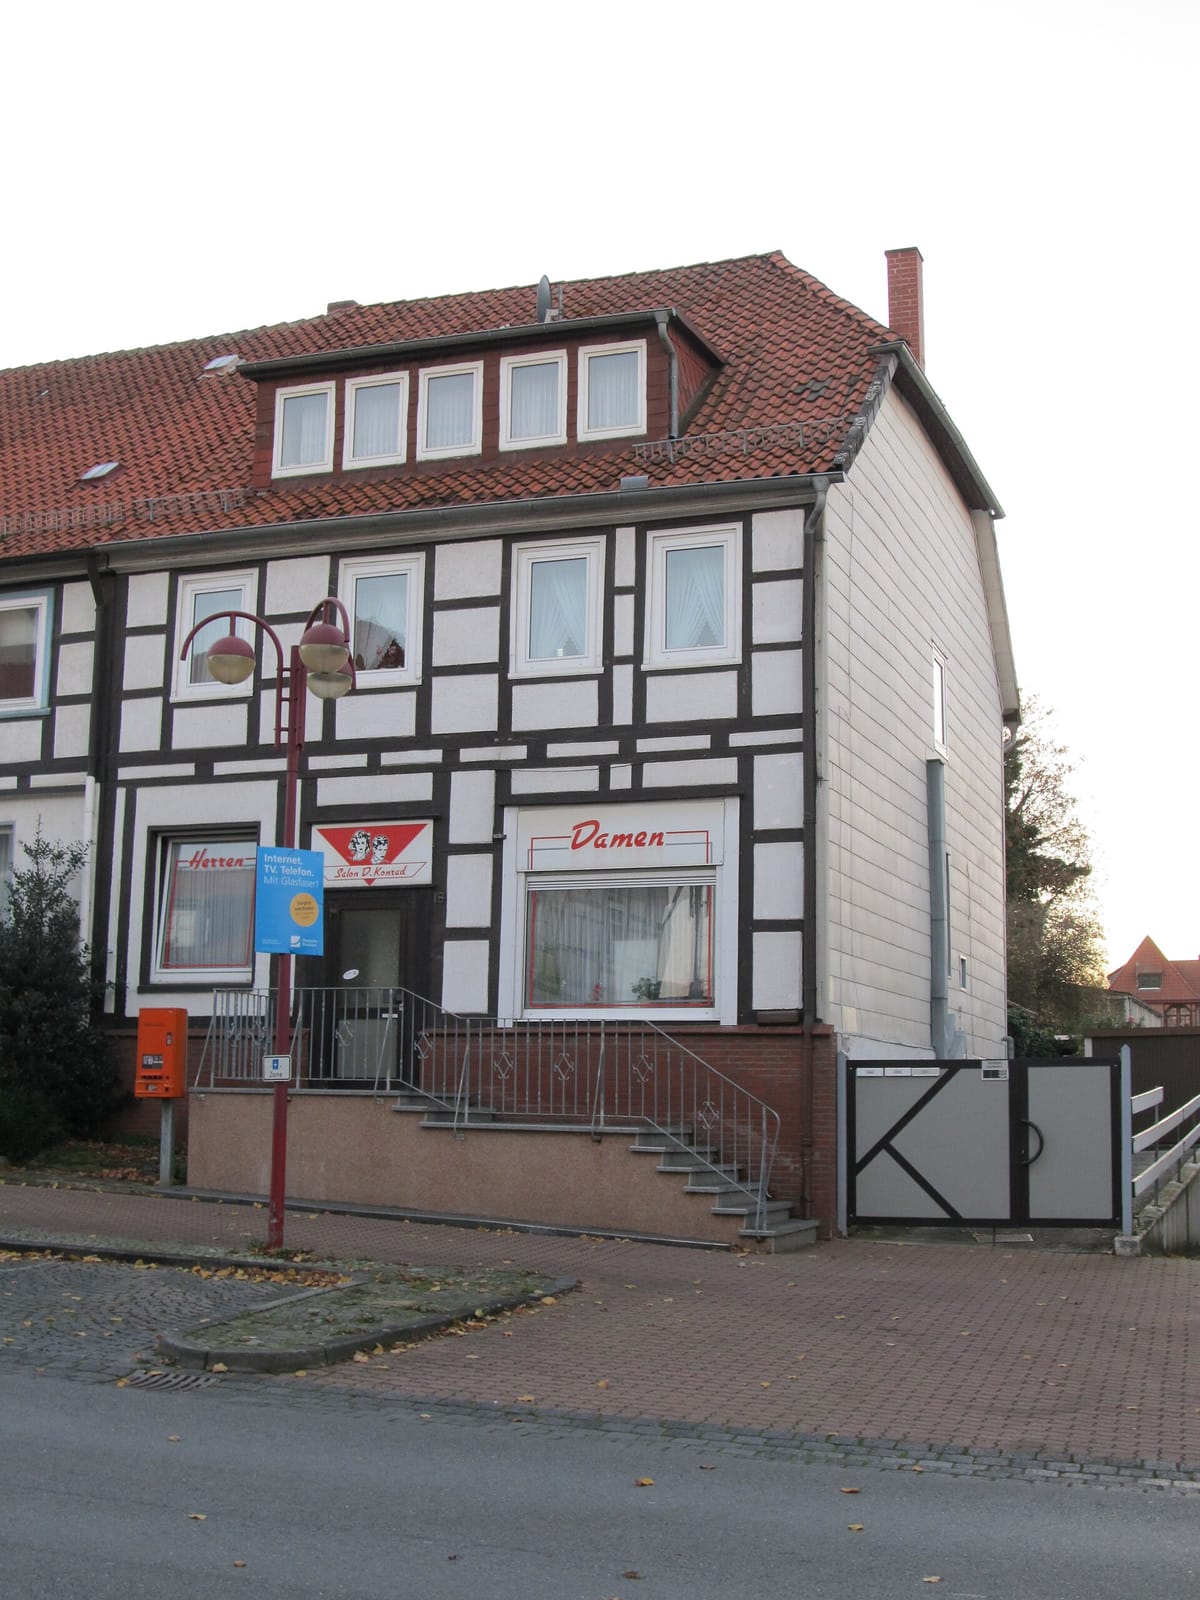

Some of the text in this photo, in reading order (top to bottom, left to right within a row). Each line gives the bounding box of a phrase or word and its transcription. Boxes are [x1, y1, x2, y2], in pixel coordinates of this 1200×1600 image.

[571, 819, 664, 850] Damen
[189, 847, 244, 869] Herren
[264, 853, 303, 865] Internet.
[280, 865, 315, 877] Telefon.
[334, 867, 359, 878] Salon
[263, 875, 319, 889] Mit Glasfaser!
